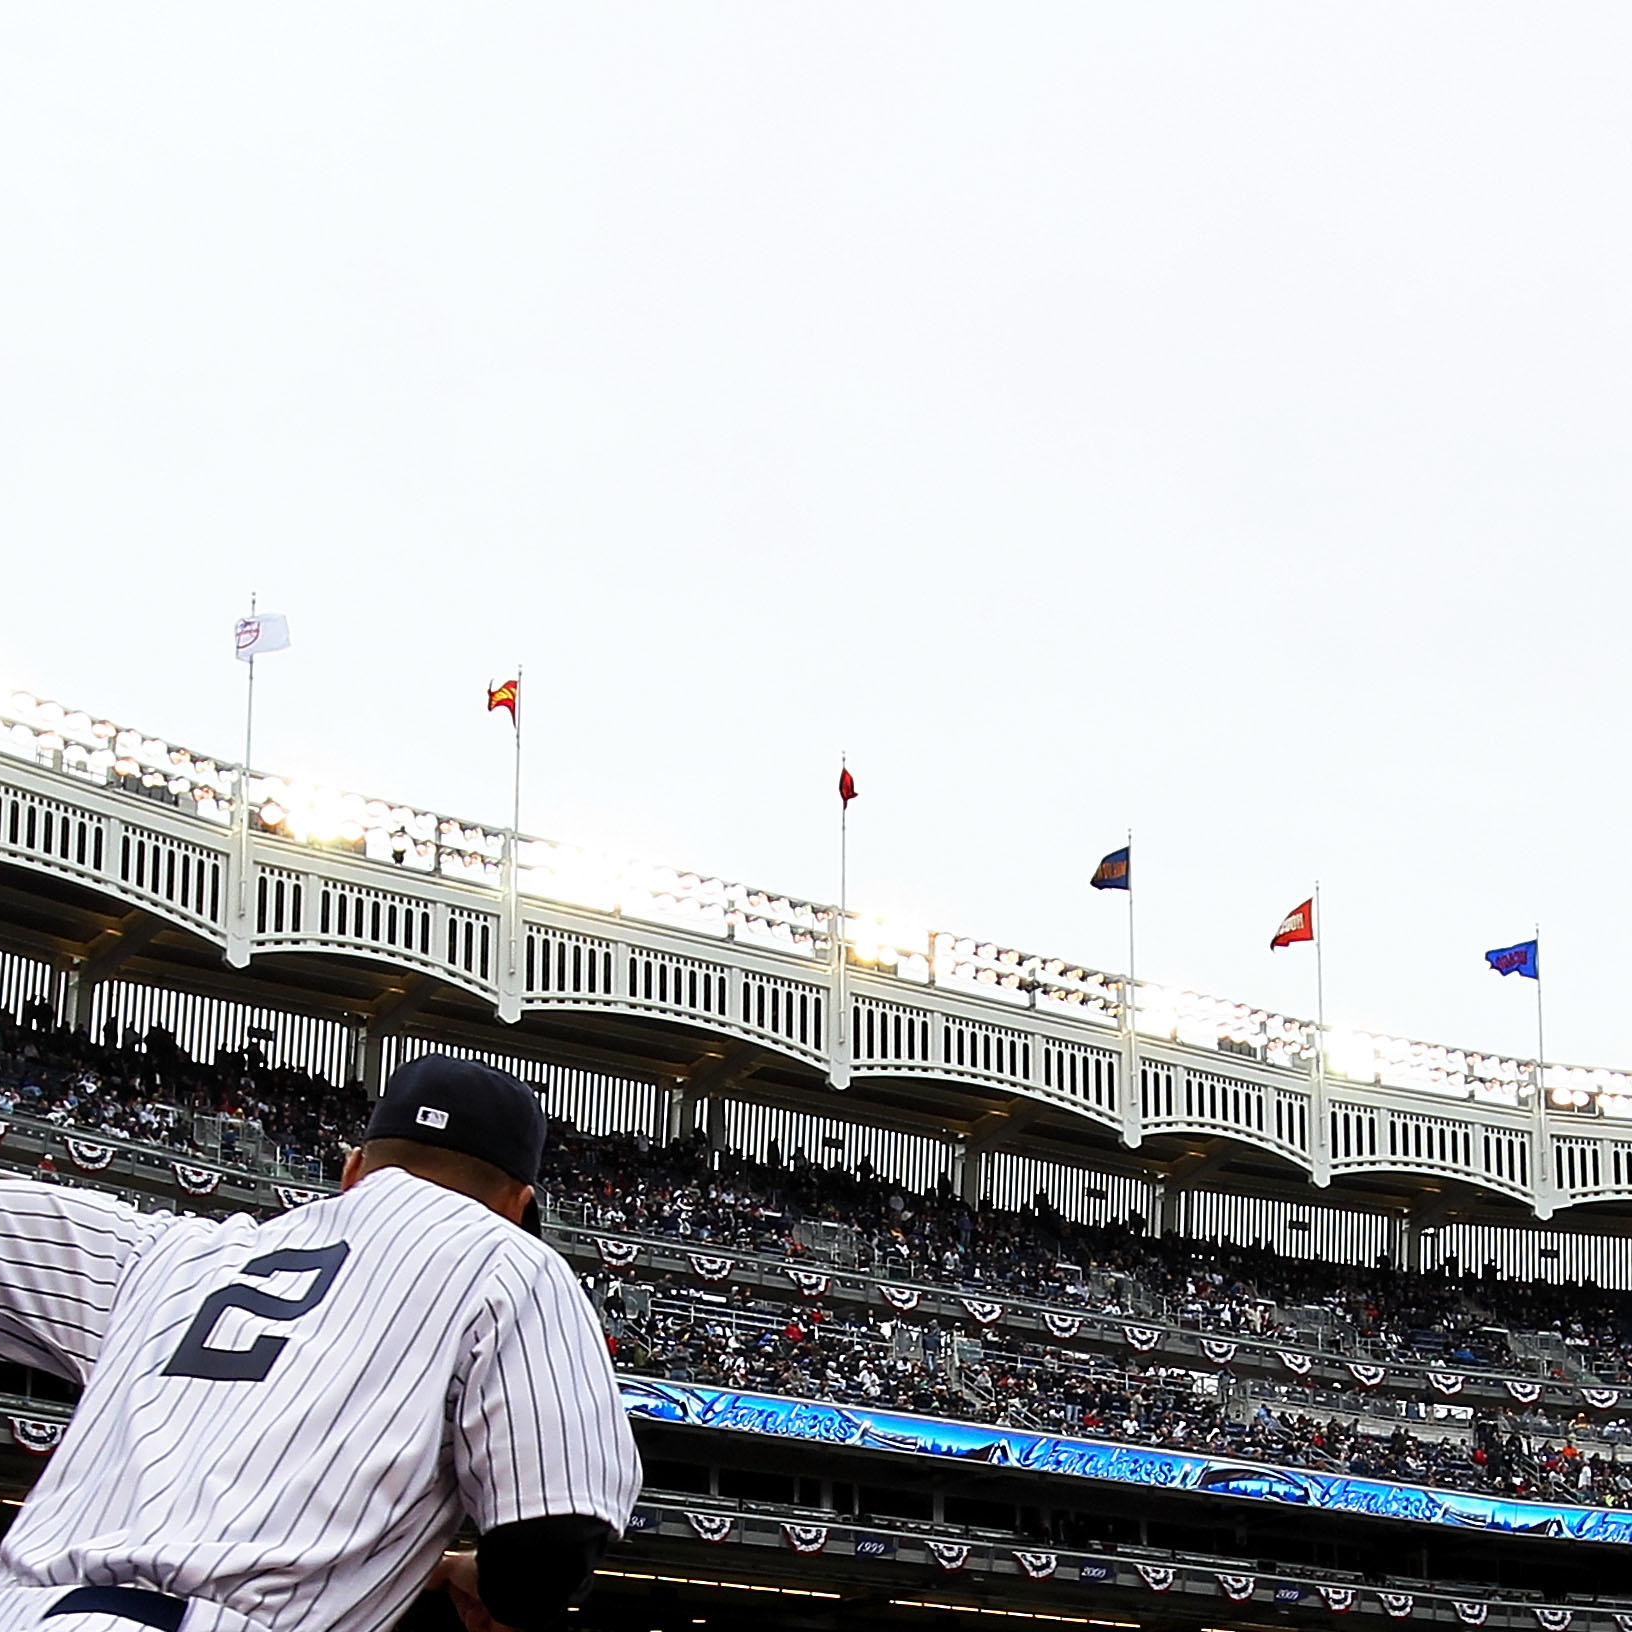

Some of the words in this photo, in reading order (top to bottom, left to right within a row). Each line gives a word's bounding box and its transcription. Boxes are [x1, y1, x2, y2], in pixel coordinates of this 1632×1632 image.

[165, 1240, 351, 1382] 2
[700, 1393, 854, 1439] Yankees
[1020, 1437, 1177, 1486] Yankees
[856, 1541, 885, 1554] 1999
